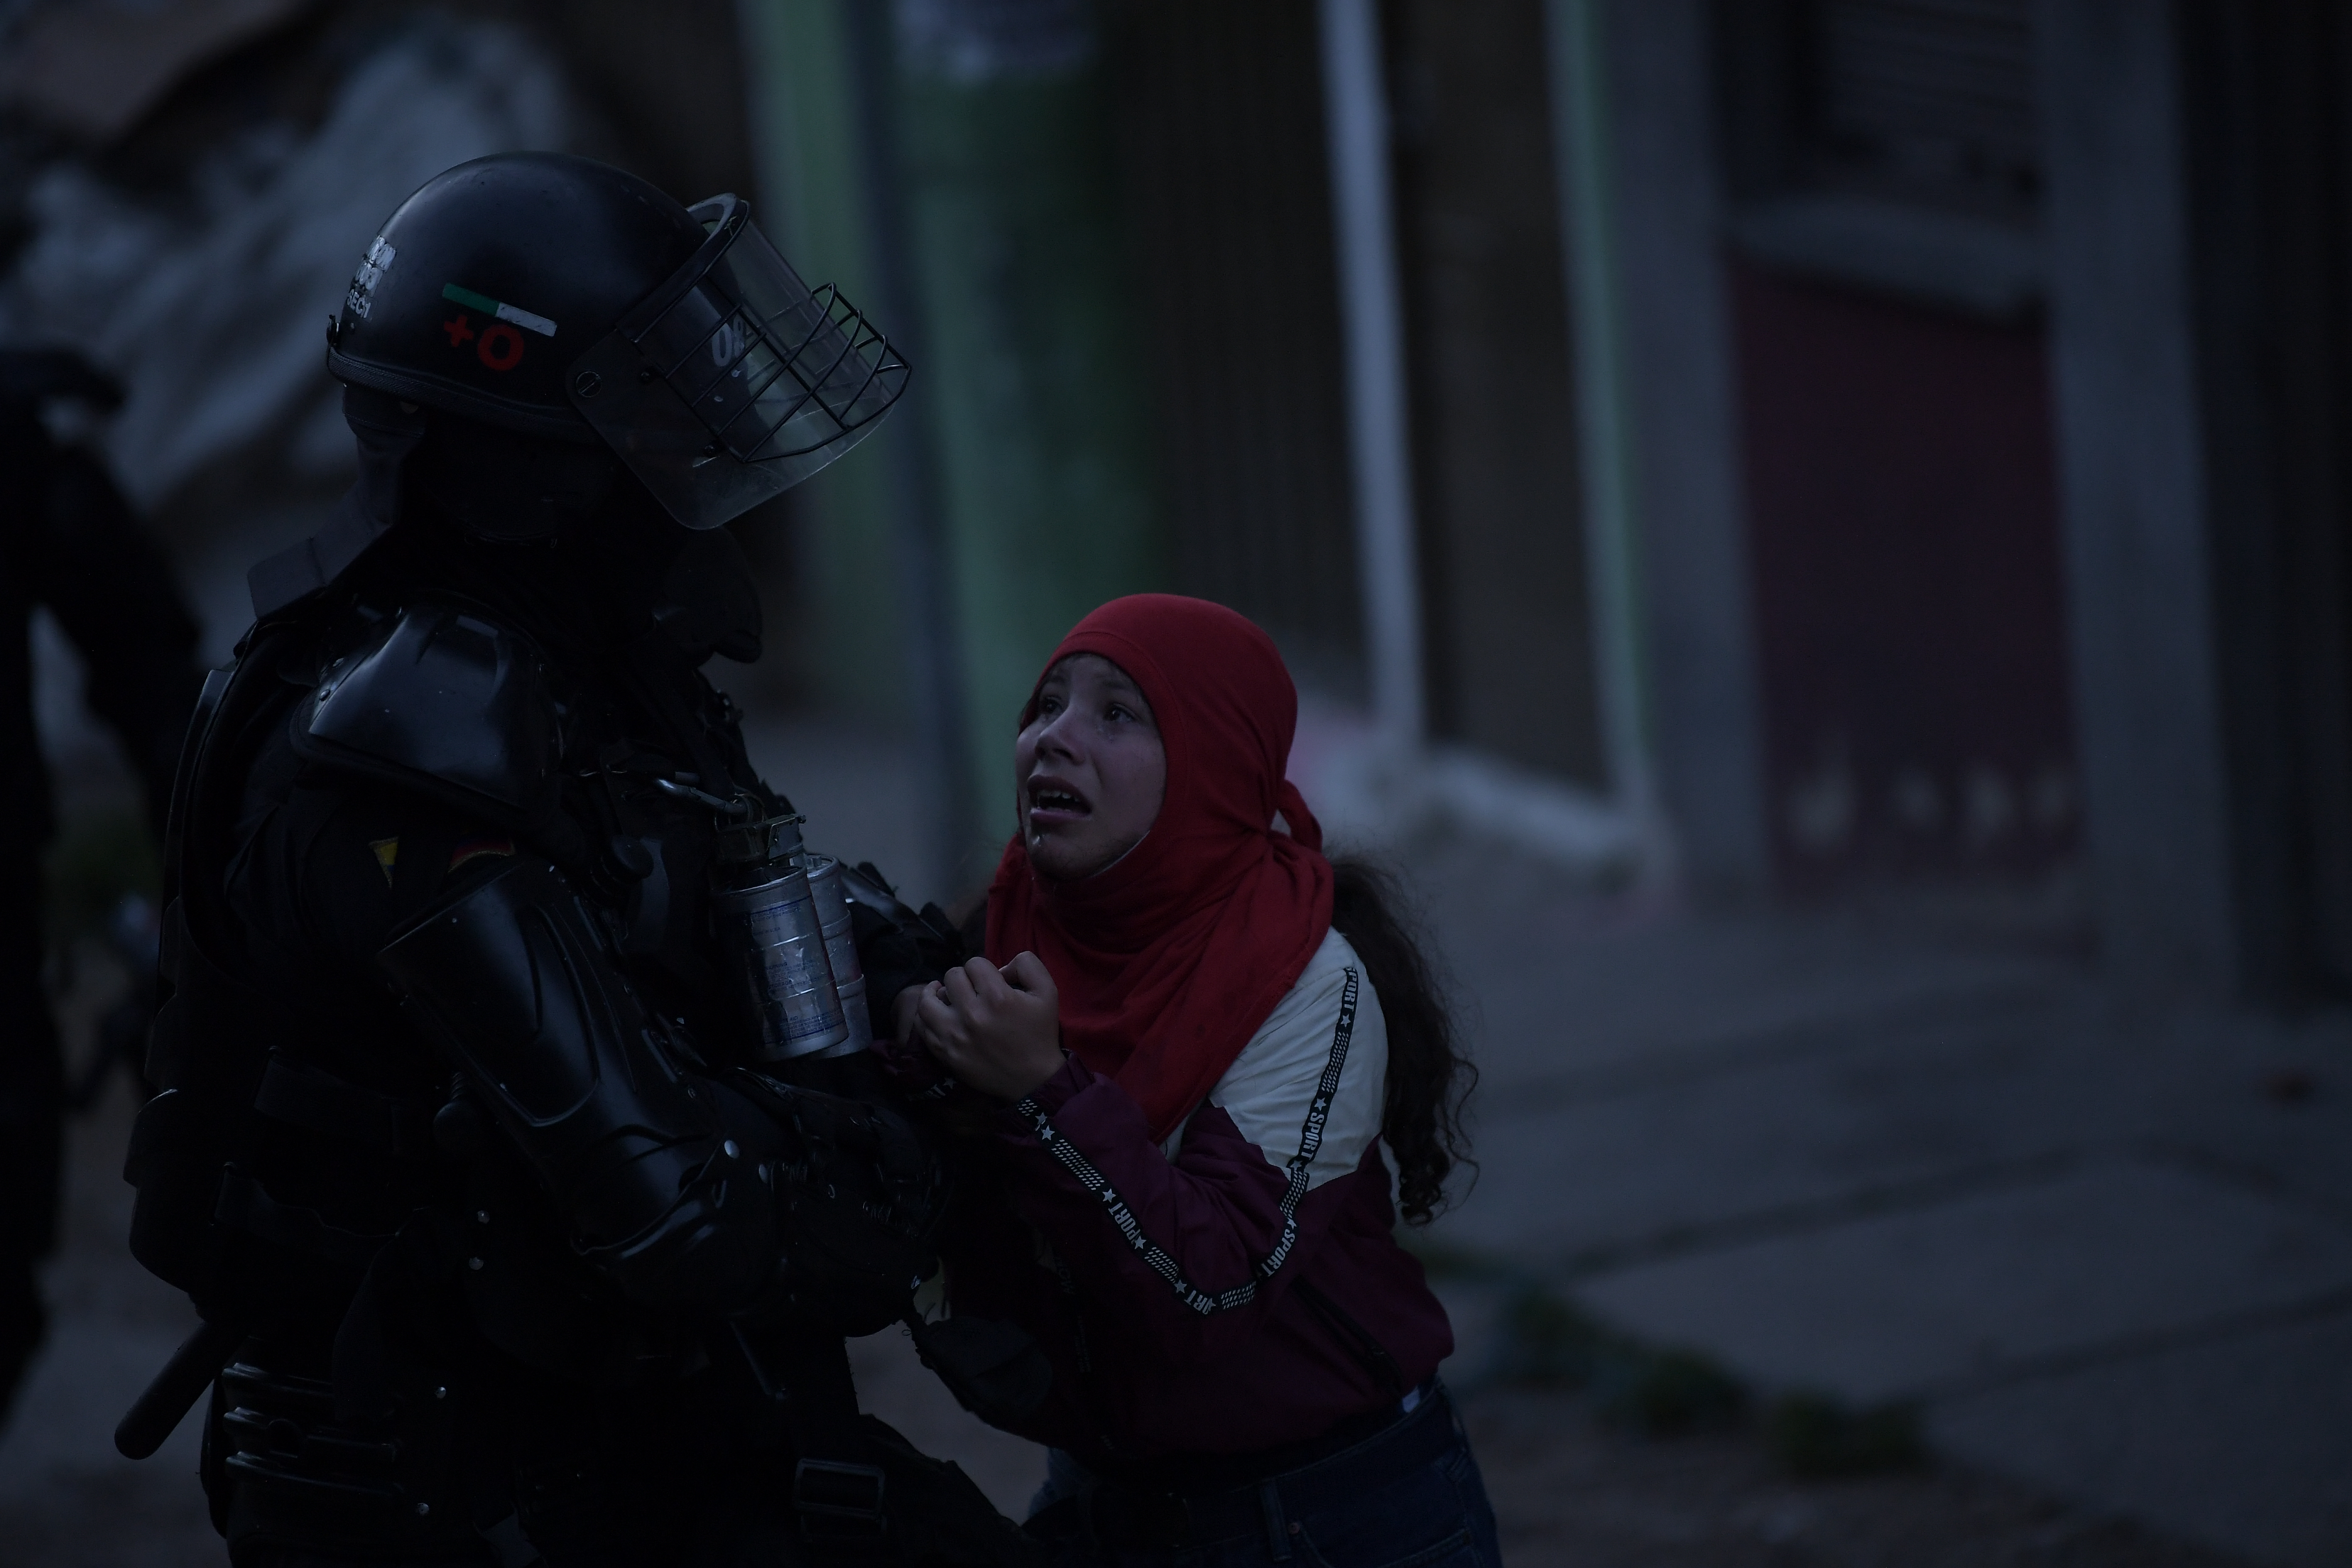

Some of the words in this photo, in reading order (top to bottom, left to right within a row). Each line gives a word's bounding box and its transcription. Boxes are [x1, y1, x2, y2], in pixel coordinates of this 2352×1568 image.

[1301, 1112, 1325, 1161] SPORT
[1108, 1202, 1141, 1244] PORT
[1261, 1228, 1296, 1277] SPORT
